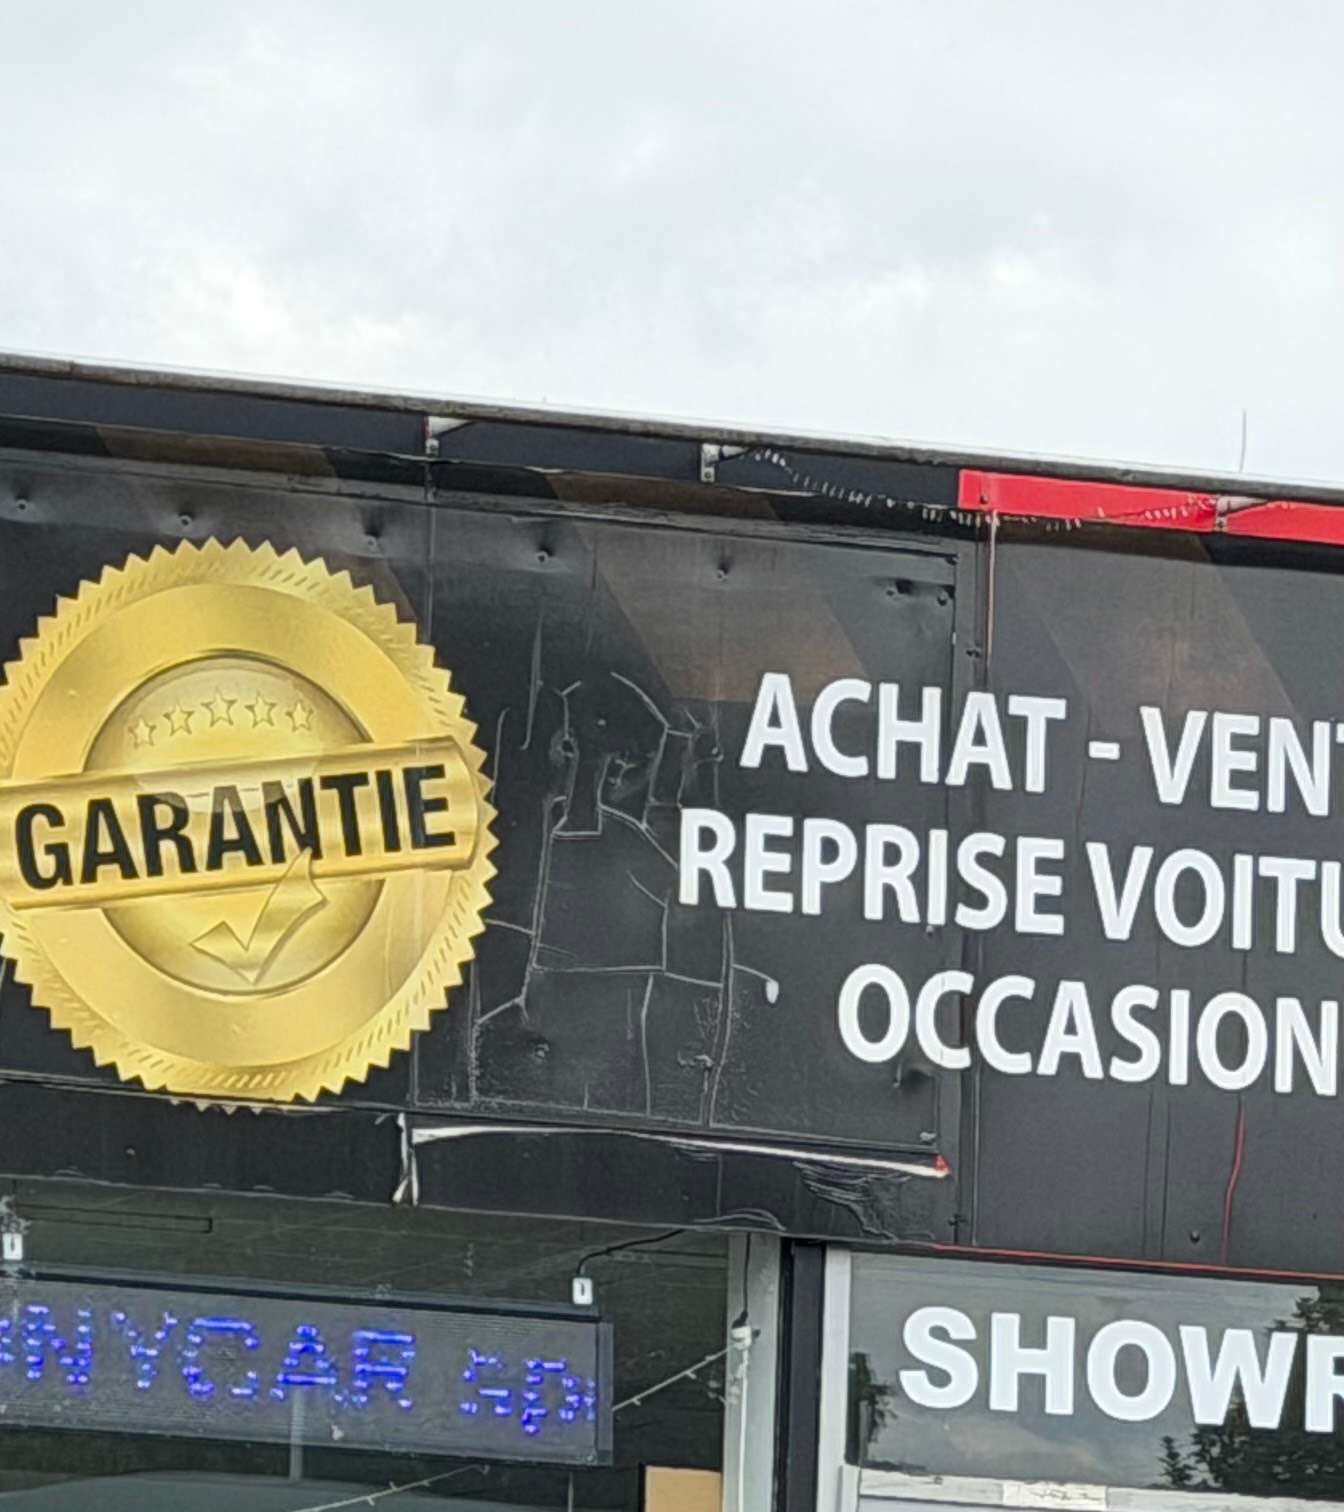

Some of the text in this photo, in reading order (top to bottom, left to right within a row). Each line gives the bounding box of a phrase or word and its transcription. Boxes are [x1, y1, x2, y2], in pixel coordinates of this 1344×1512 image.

[740, 673, 1344, 816] ACHAT - VEN
[15, 763, 457, 894] GARANTIE
[680, 809, 1064, 934] REPRISE
[839, 964, 1338, 1096] OCCASION
